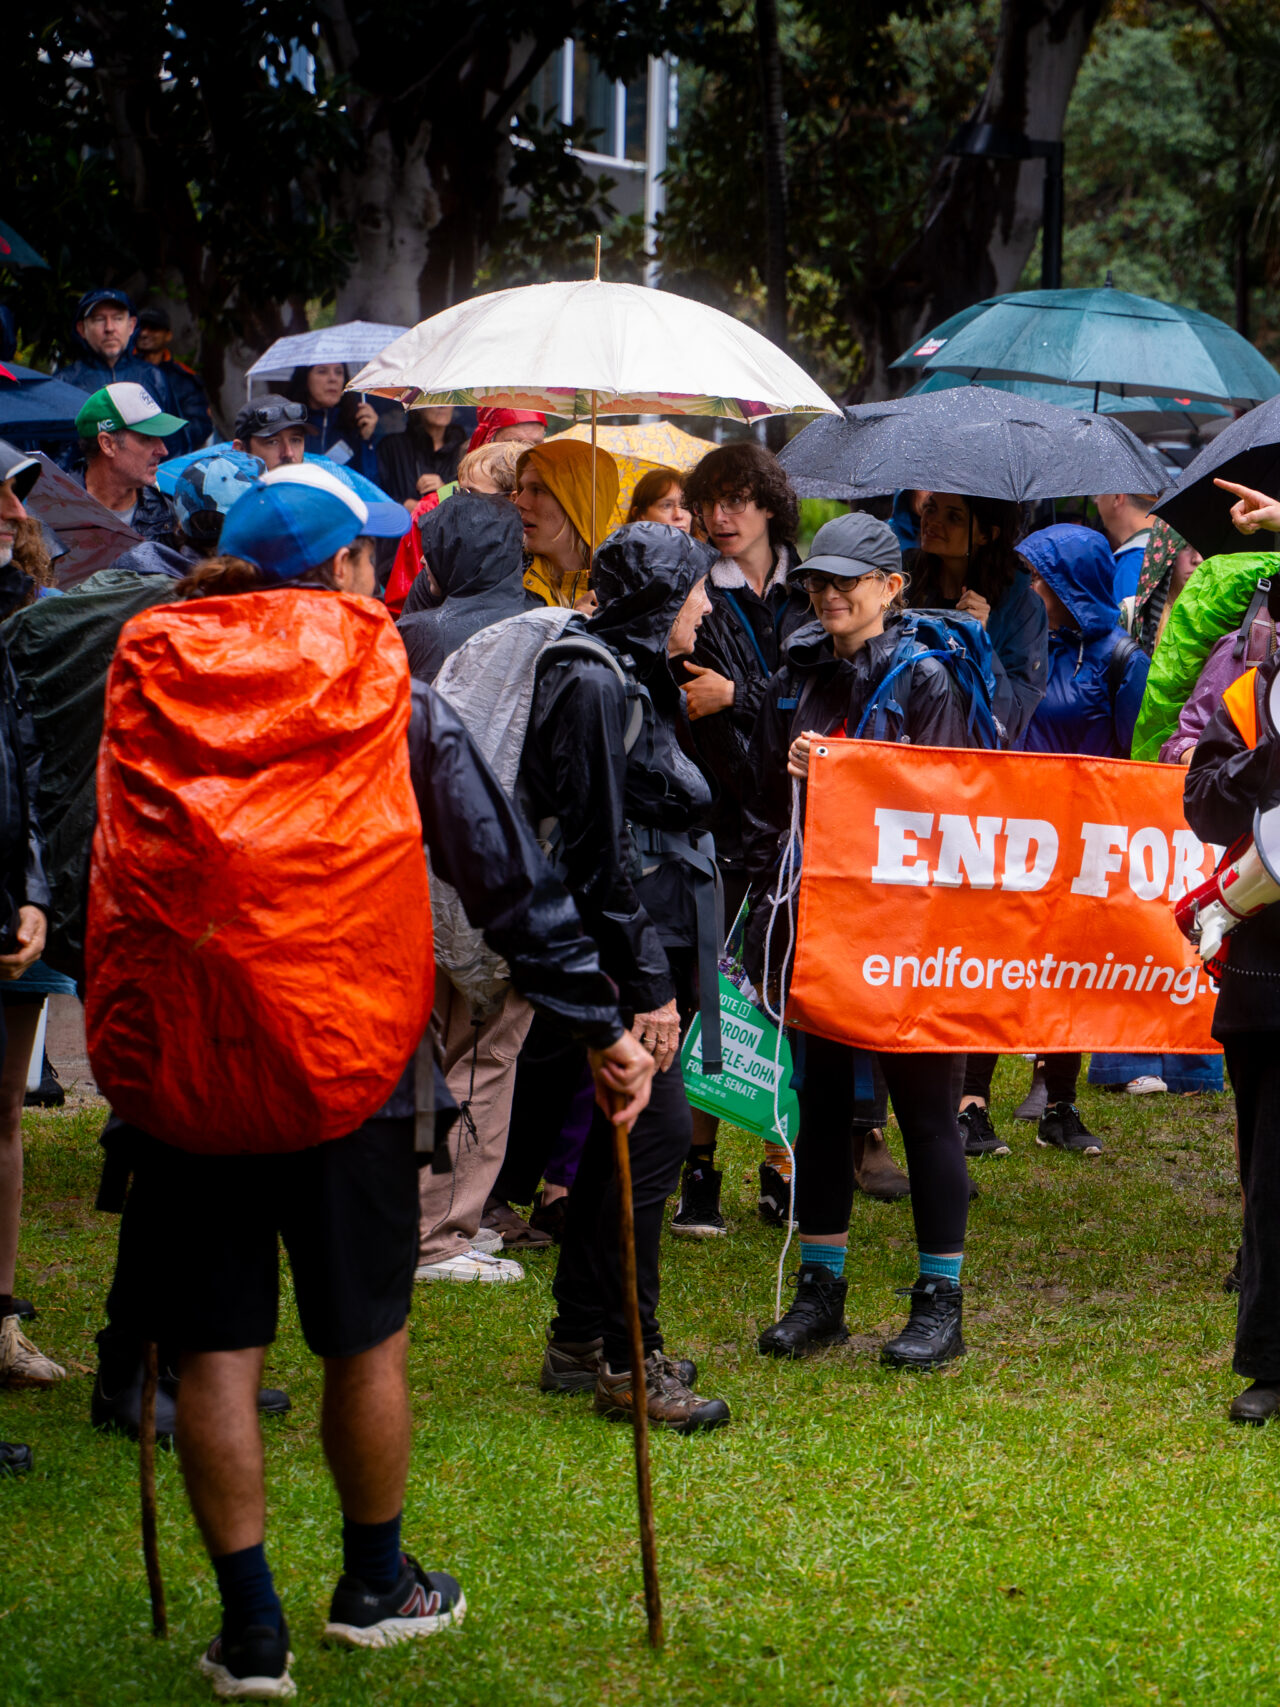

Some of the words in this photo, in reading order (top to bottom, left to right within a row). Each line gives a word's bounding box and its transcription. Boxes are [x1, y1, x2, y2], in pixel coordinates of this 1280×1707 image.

[871, 808, 1060, 892] END
[1070, 822, 1227, 902] FOR
[723, 1077, 759, 1100] SENATE
